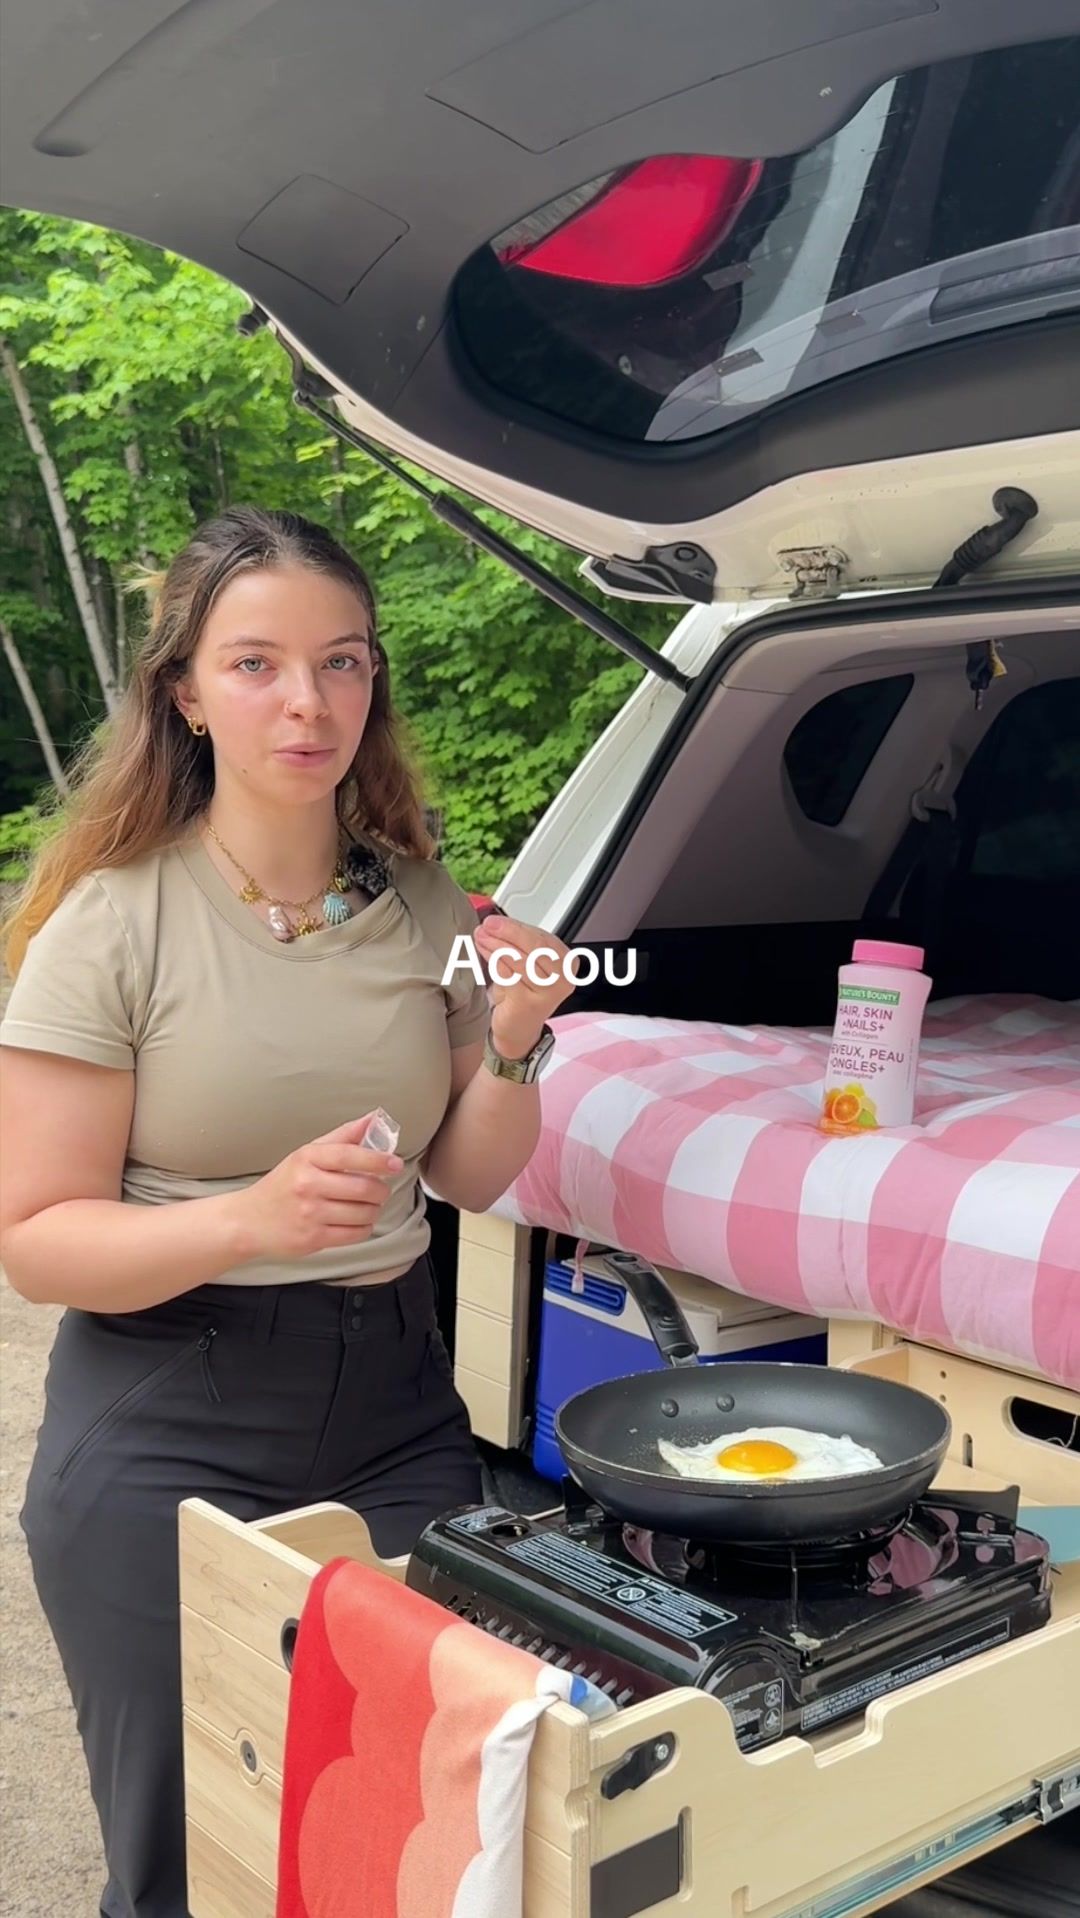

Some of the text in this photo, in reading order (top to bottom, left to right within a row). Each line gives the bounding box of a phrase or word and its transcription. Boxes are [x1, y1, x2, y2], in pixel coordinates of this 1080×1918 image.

[867, 990, 897, 1001] BOUNTY
[863, 1007, 892, 1020] SKIN
[869, 1048, 904, 1063] PEAU
